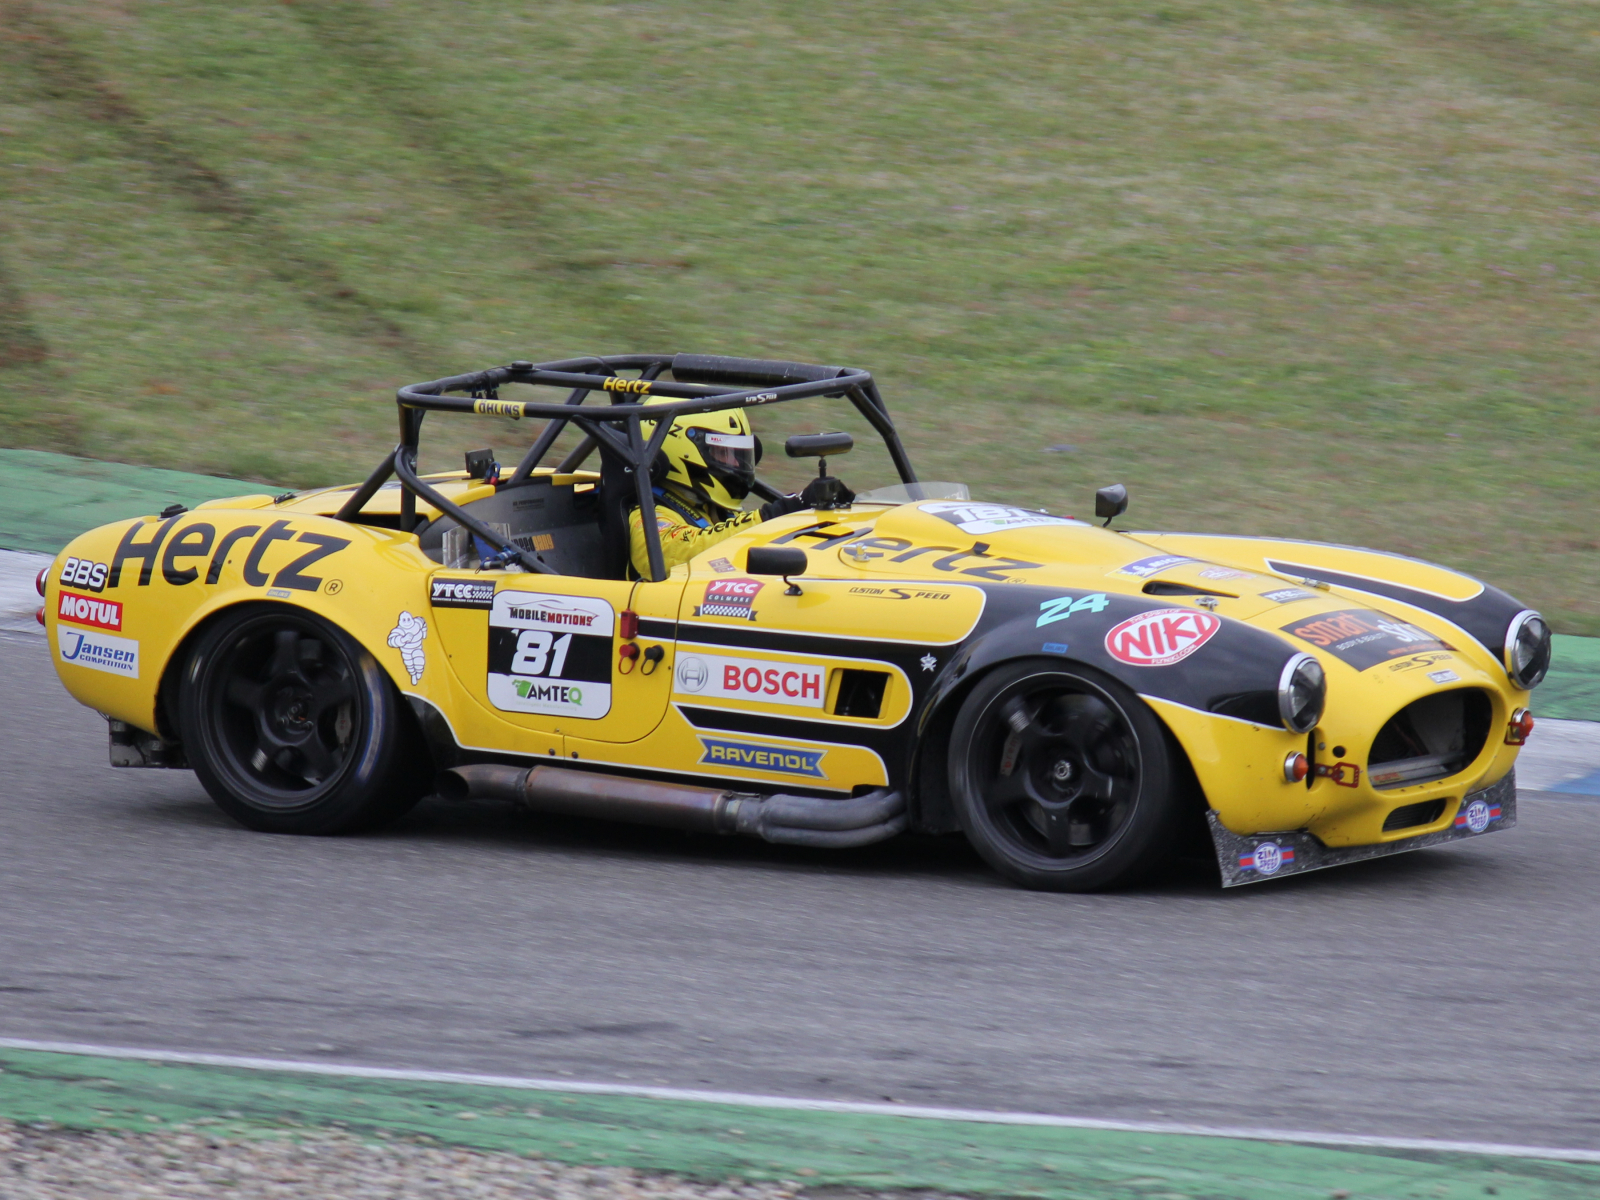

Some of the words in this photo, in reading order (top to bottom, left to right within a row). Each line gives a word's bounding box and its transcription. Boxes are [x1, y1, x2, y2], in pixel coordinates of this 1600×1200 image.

[603, 376, 652, 394] Hertz
[953, 507, 1030, 522] 181
[107, 514, 352, 592] Hertz
[769, 520, 1046, 581] Hertz
[60, 556, 108, 593] BBS
[432, 583, 474, 598] YTCC
[708, 594, 750, 603] COLMORE
[710, 581, 758, 594] YTCC
[849, 587, 885, 595] CUSTOM
[889, 588, 951, 600] SPEED
[60, 595, 119, 625] MOTUL
[507, 607, 593, 626] MOBILEMOTIONS
[1036, 593, 1110, 628] 24
[62, 632, 135, 662] Jansen
[1119, 614, 1208, 656] NIKI
[80, 654, 133, 670] COMPETITION
[723, 665, 820, 699] BOSCH
[527, 684, 582, 706] AMTEQ
[711, 745, 814, 771] RAVENOL
